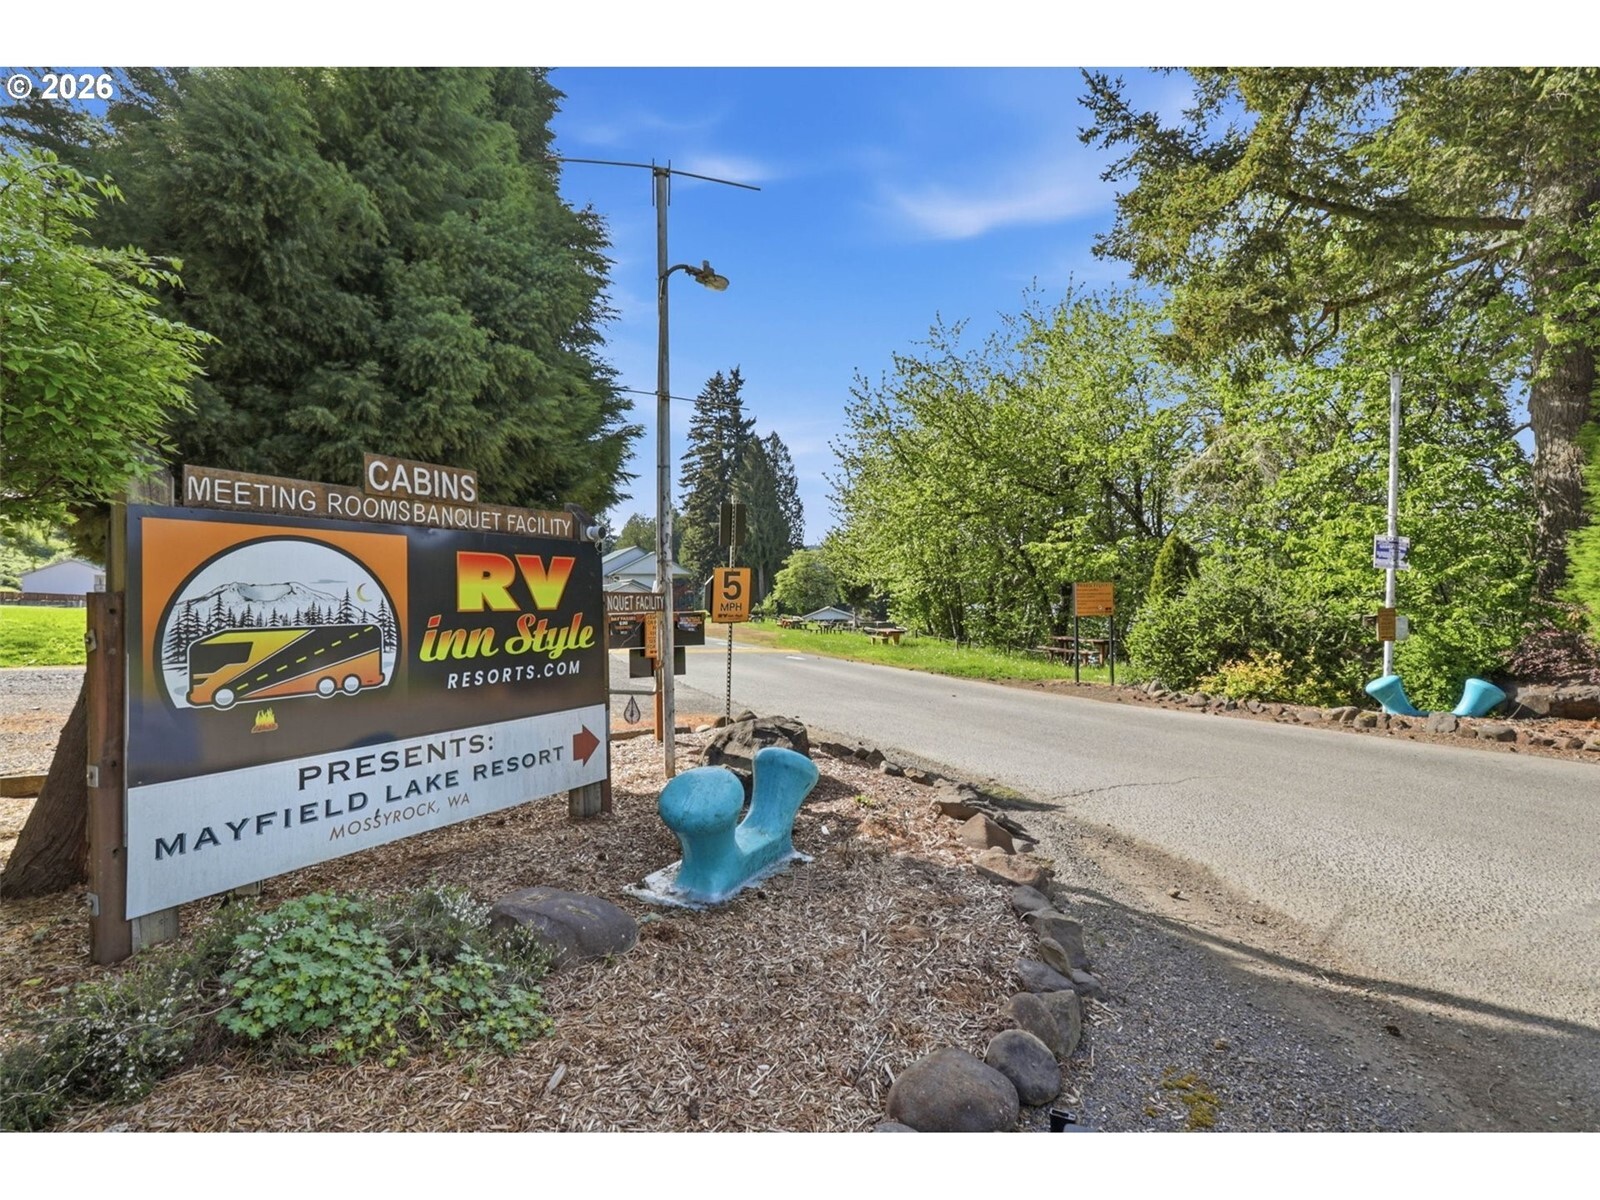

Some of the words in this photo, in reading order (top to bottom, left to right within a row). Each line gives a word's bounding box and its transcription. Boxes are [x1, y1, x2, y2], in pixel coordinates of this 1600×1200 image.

[188, 476, 316, 512] MEETING
[328, 493, 411, 522] ROOMS
[368, 460, 476, 502] CABINS
[413, 503, 502, 532] BANQUET
[507, 514, 571, 536] FACILITY
[457, 551, 576, 612] RV
[723, 571, 742, 600] 5
[607, 595, 634, 611] NQUET
[636, 594, 664, 610] FACILITY
[720, 602, 742, 611] MPH
[419, 614, 499, 662] inn
[504, 612, 595, 660] Style
[447, 660, 580, 689] RESORTS.COM
[298, 734, 494, 791] PRESENTS:
[155, 791, 368, 861] MAYFIELD
[386, 770, 459, 803] LAKE
[473, 745, 564, 782] RESORT
[447, 792, 470, 808] WA
